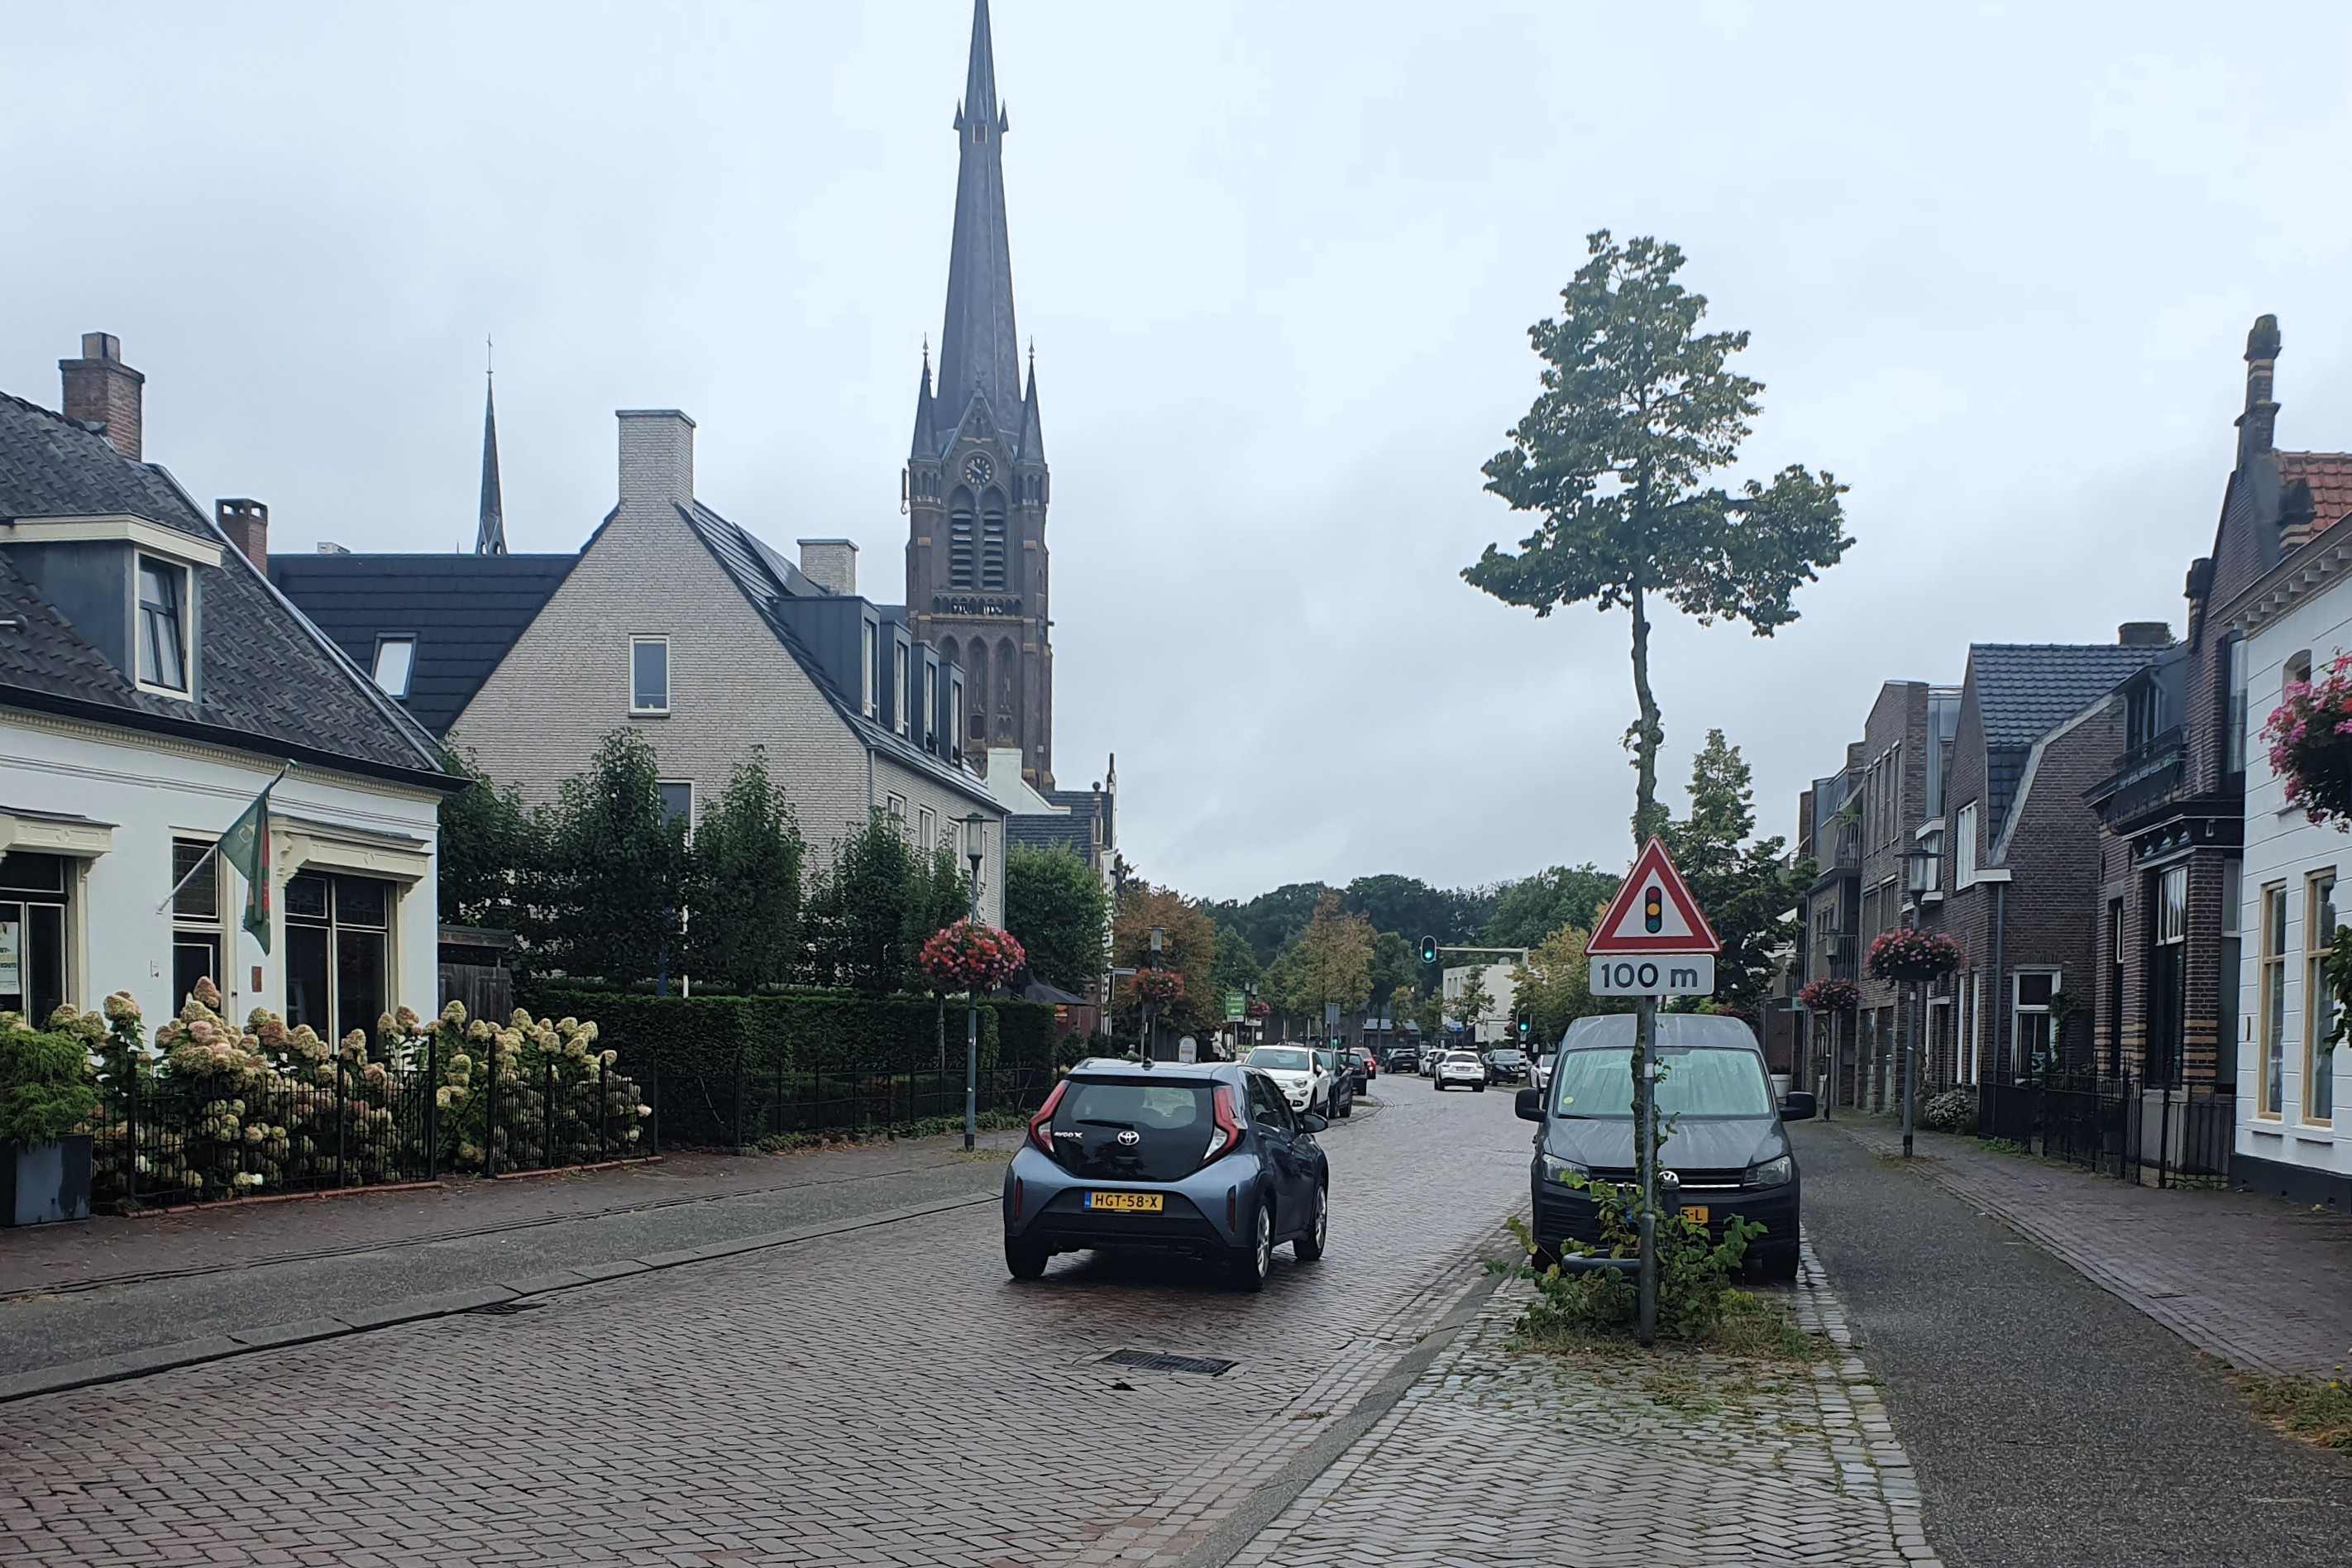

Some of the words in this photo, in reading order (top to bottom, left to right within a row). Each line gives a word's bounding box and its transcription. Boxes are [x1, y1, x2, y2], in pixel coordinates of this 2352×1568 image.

[1601, 963, 1659, 988] 100
[1671, 968, 1698, 987] m
[1095, 1193, 1158, 1208] HGT-58-X
